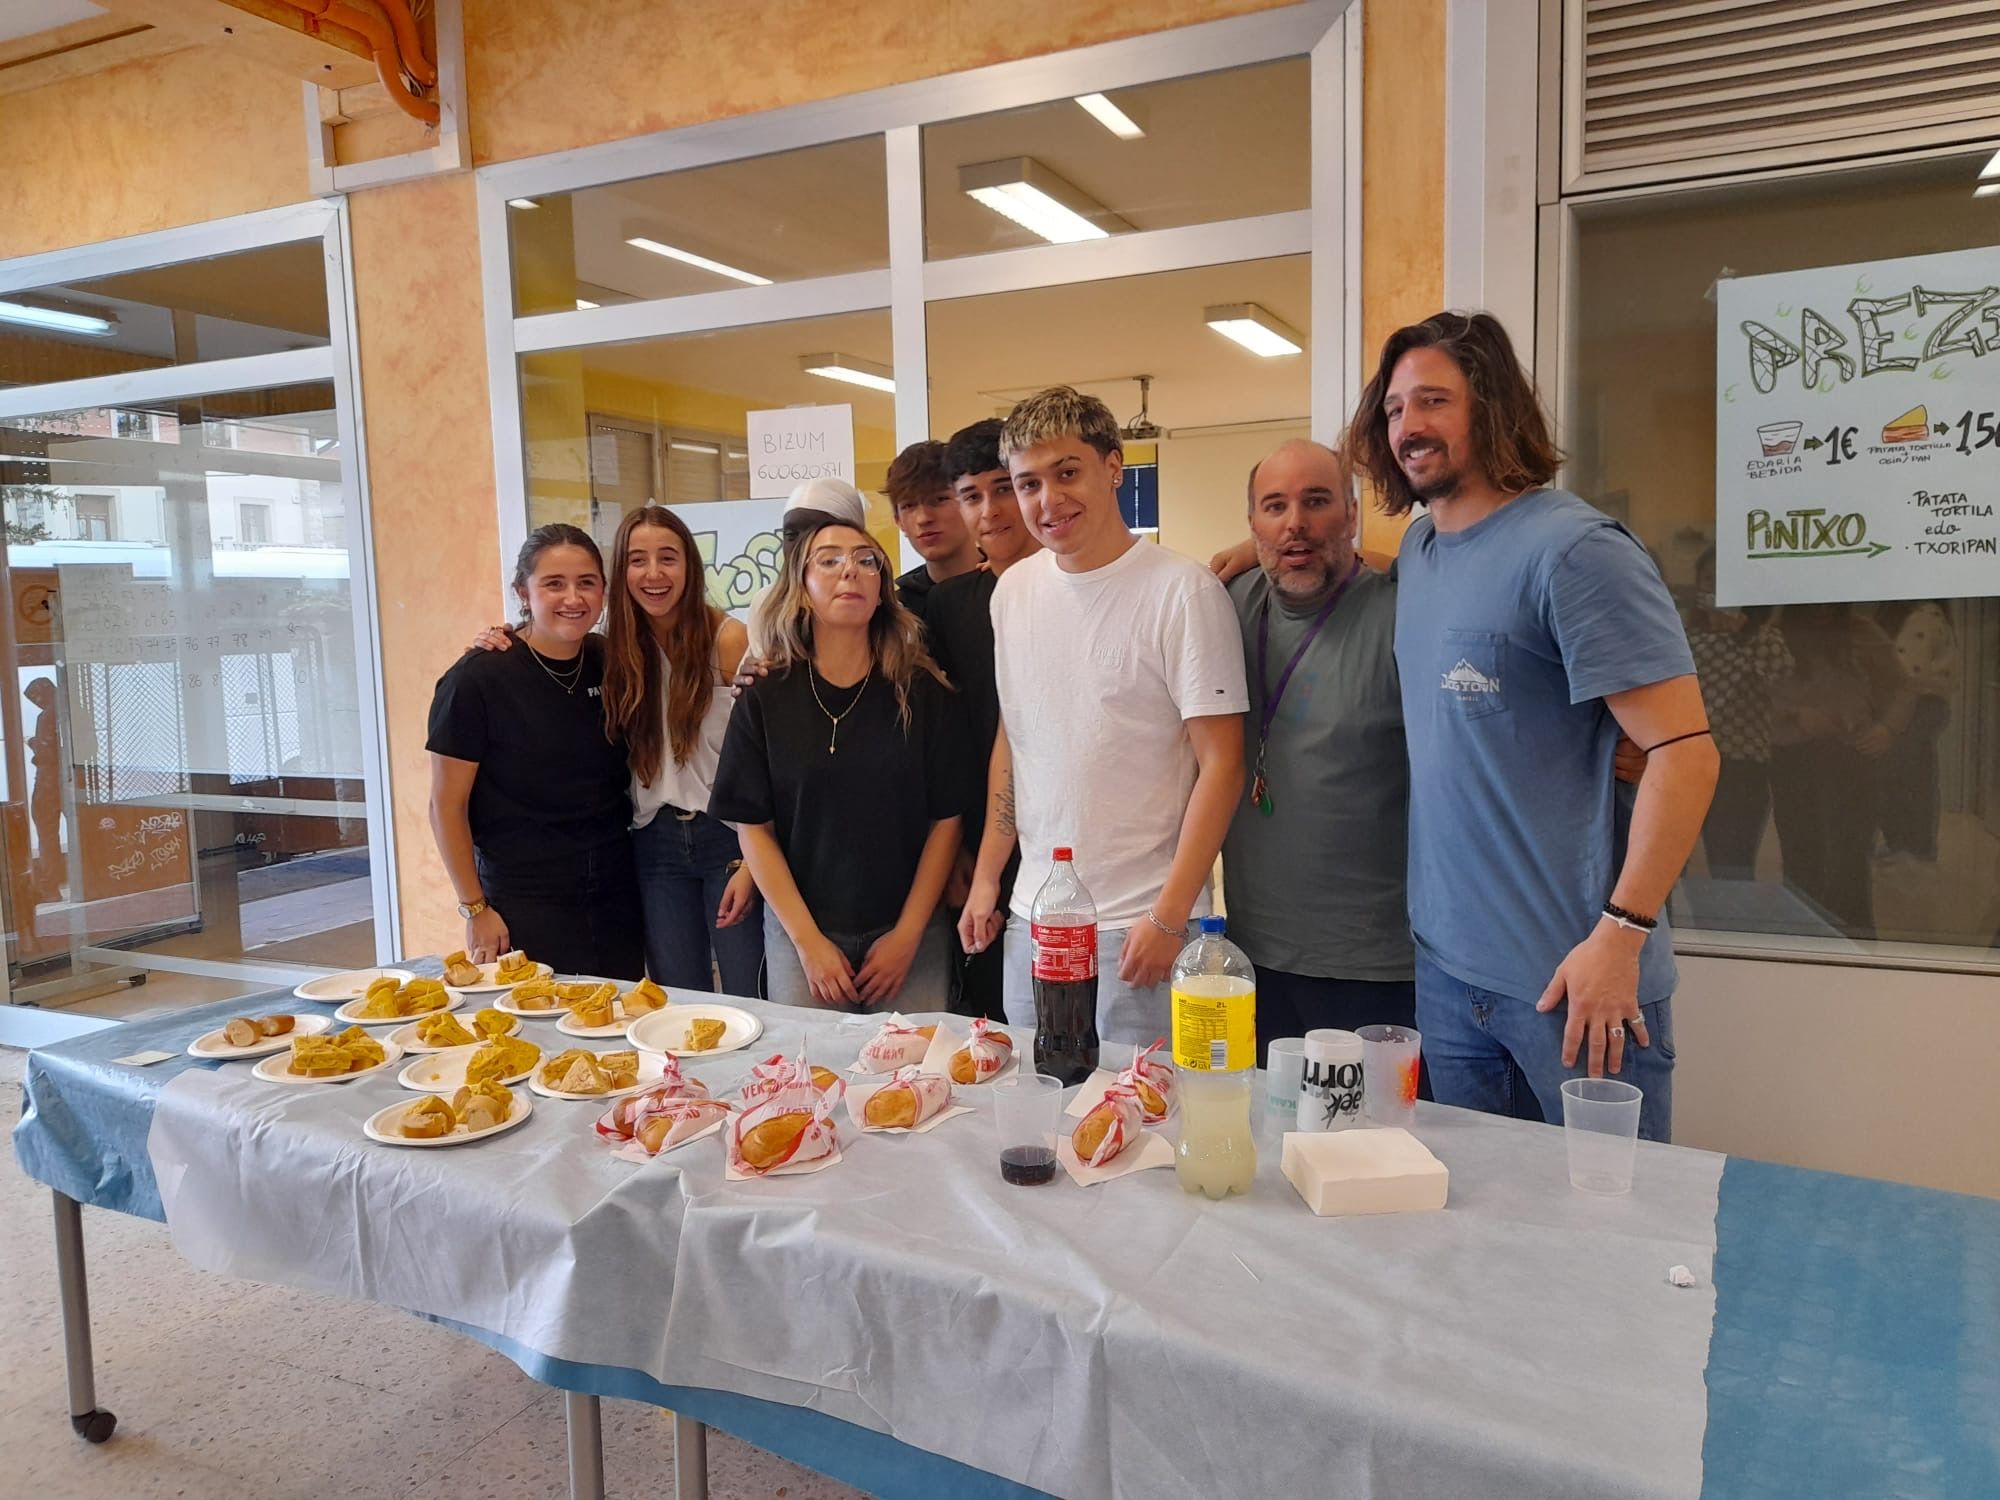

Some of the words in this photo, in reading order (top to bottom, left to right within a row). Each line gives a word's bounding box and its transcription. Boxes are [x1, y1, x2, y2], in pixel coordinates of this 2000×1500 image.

[763, 431, 825, 454] BIZUM
[1823, 426, 1858, 465] 1€
[1746, 455, 1802, 471] EDARIA
[1746, 464, 1803, 479] BEBIDA
[1913, 490, 1968, 507] PATATA
[1930, 504, 1993, 518] TORTILA
[1925, 520, 1961, 535] edo
[1913, 537, 1997, 555] TXORIPAN
[184, 635, 201, 653] 76
[206, 634, 220, 650] 77
[231, 632, 249, 648] 78
